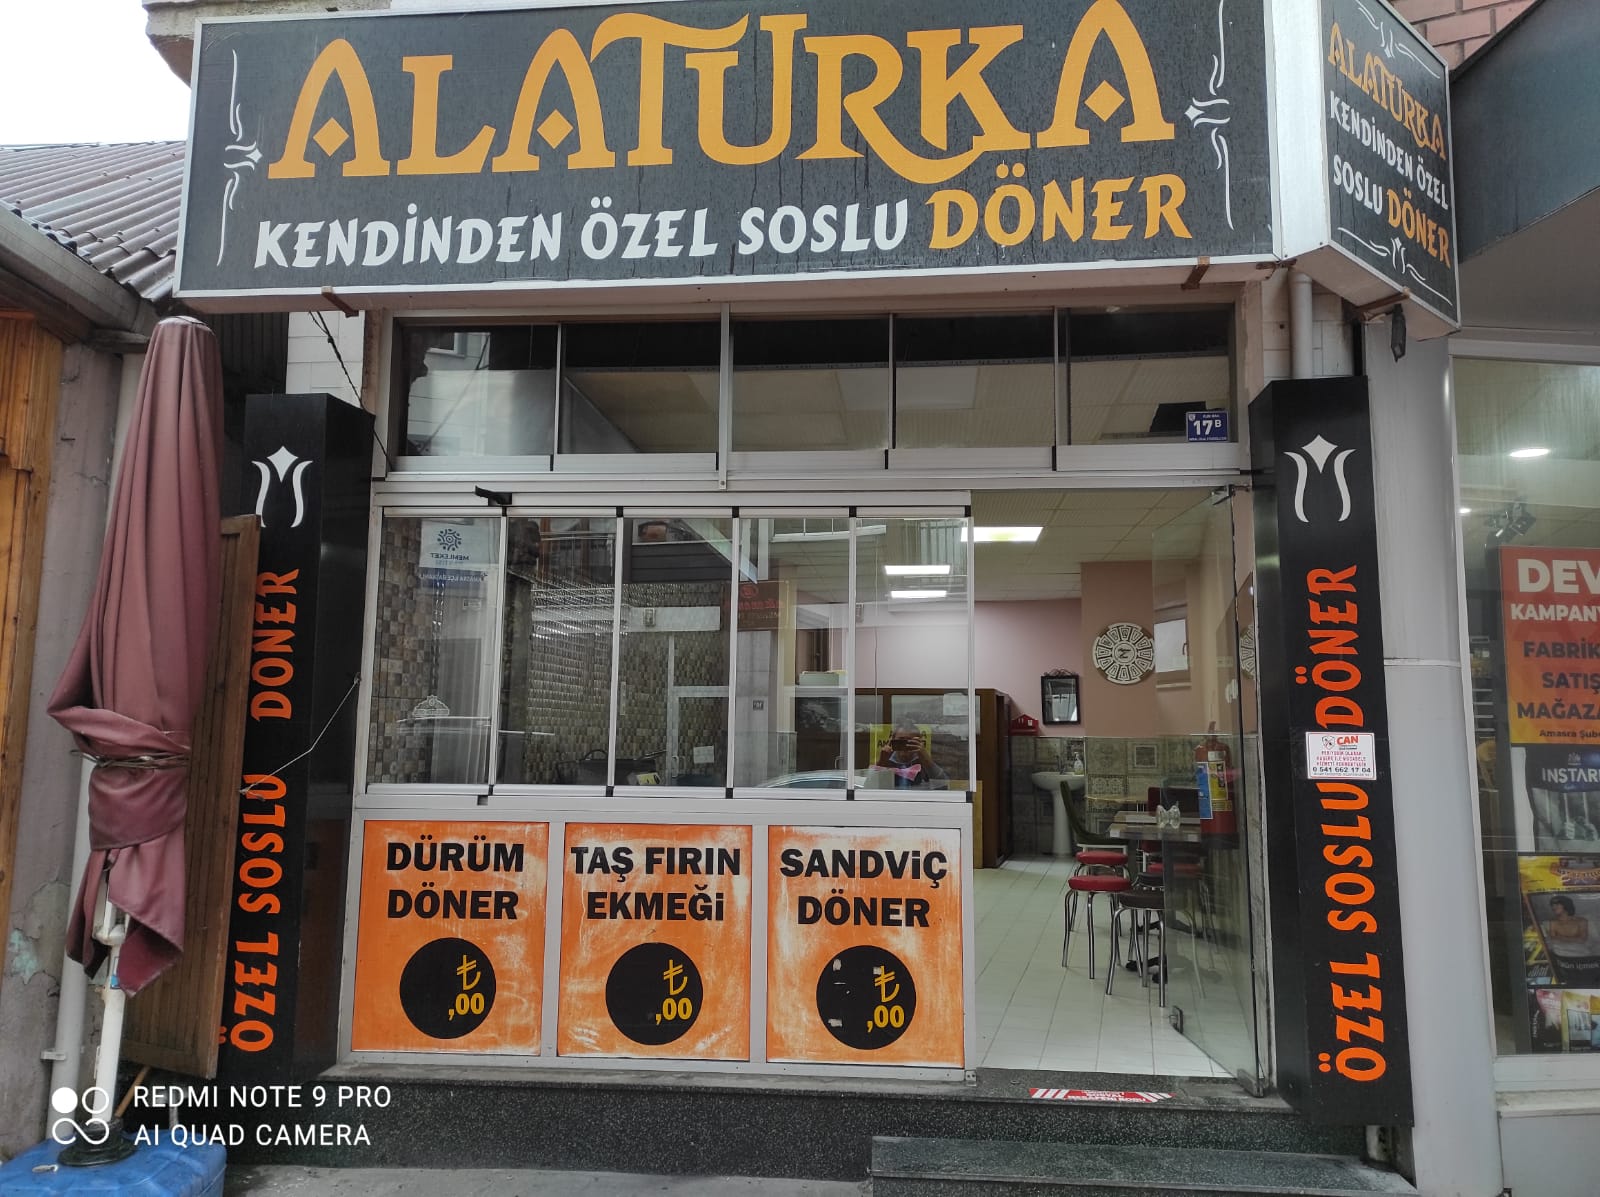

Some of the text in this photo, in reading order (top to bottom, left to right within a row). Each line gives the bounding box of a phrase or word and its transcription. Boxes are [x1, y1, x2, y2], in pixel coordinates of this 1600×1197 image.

[268, 0, 1175, 184] ALATURKA
[1327, 22, 1447, 161] ALATURKA
[1330, 90, 1449, 211] KENDİNDEN ÖZEL
[254, 162, 1193, 269] KENDİNDEN ÖZEL SOSLU DÖNER
[1333, 154, 1451, 269] SOSLU DÖNER
[1518, 558, 1600, 595] DEV
[1511, 603, 1600, 622] KAMPAN
[1294, 565, 1364, 729] DÖNER
[1542, 671, 1600, 695] SATIŞ
[1517, 698, 1600, 720] MAĞAZ
[1336, 735, 1359, 745] CAN
[1539, 729, 1577, 737] Amasra
[1542, 767, 1600, 784] INSTAR
[238, 774, 287, 914] SOSLU
[387, 834, 525, 872] DÜRÜM
[1315, 782, 1378, 933] SOSLU
[571, 846, 741, 883] TAŞ FIRIN
[387, 881, 519, 919] DÖNER
[798, 888, 930, 927] DÖNER
[218, 932, 279, 1052] ÖZEL
[448, 993, 485, 1021] ,00
[655, 998, 692, 1026] ,00
[867, 1005, 904, 1033] ,00
[1318, 952, 1387, 1082] ÖZEL
